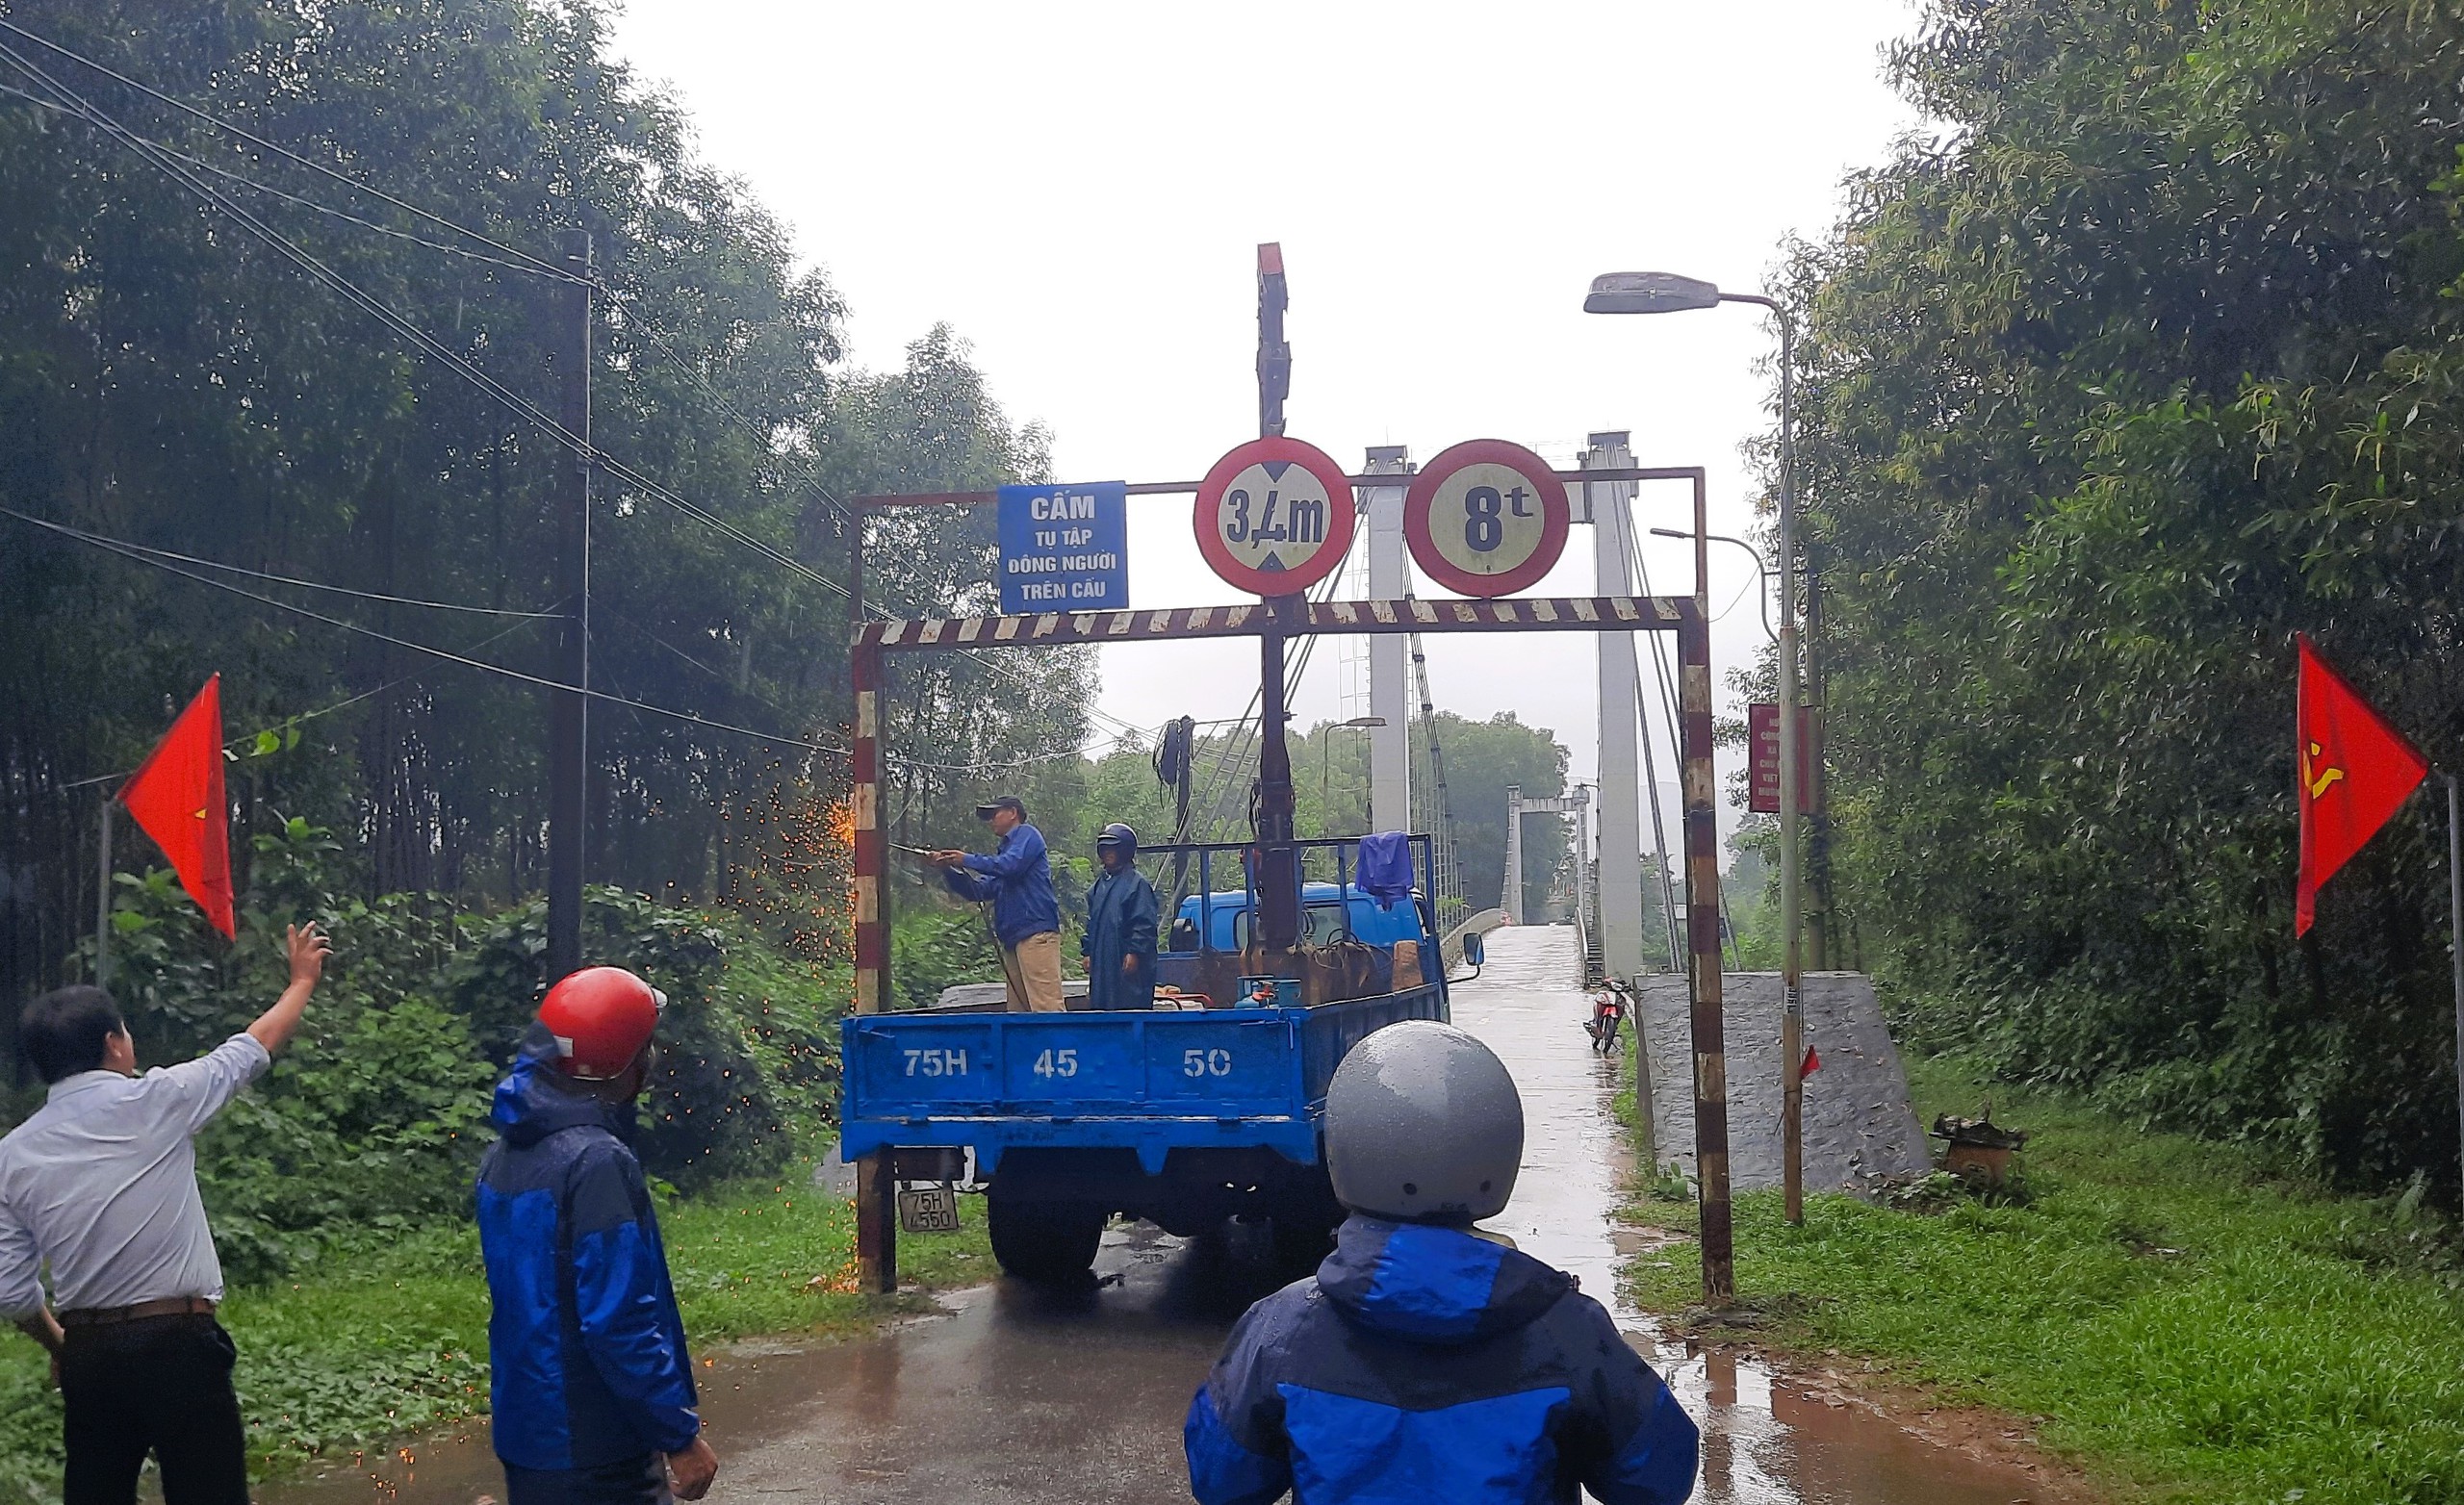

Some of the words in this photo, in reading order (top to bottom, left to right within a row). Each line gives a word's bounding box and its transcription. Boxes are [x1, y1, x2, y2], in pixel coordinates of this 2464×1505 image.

[1031, 490, 1095, 521] CẤM
[1227, 489, 1323, 549] 3,4m
[1465, 486, 1534, 552] 8t
[1035, 530, 1057, 550] TỤ
[1062, 526, 1092, 548] TẬP
[1008, 554, 1057, 574] ĐÔNG
[1062, 548, 1116, 572] NGƯỜI
[1021, 580, 1066, 600] TRÊN
[1071, 577, 1106, 599] CẦU
[904, 1049, 967, 1077] 75H
[1033, 1049, 1078, 1079] 45
[1184, 1048, 1231, 1077] 50
[908, 1193, 943, 1212] 75H
[910, 1211, 951, 1229] 4550
